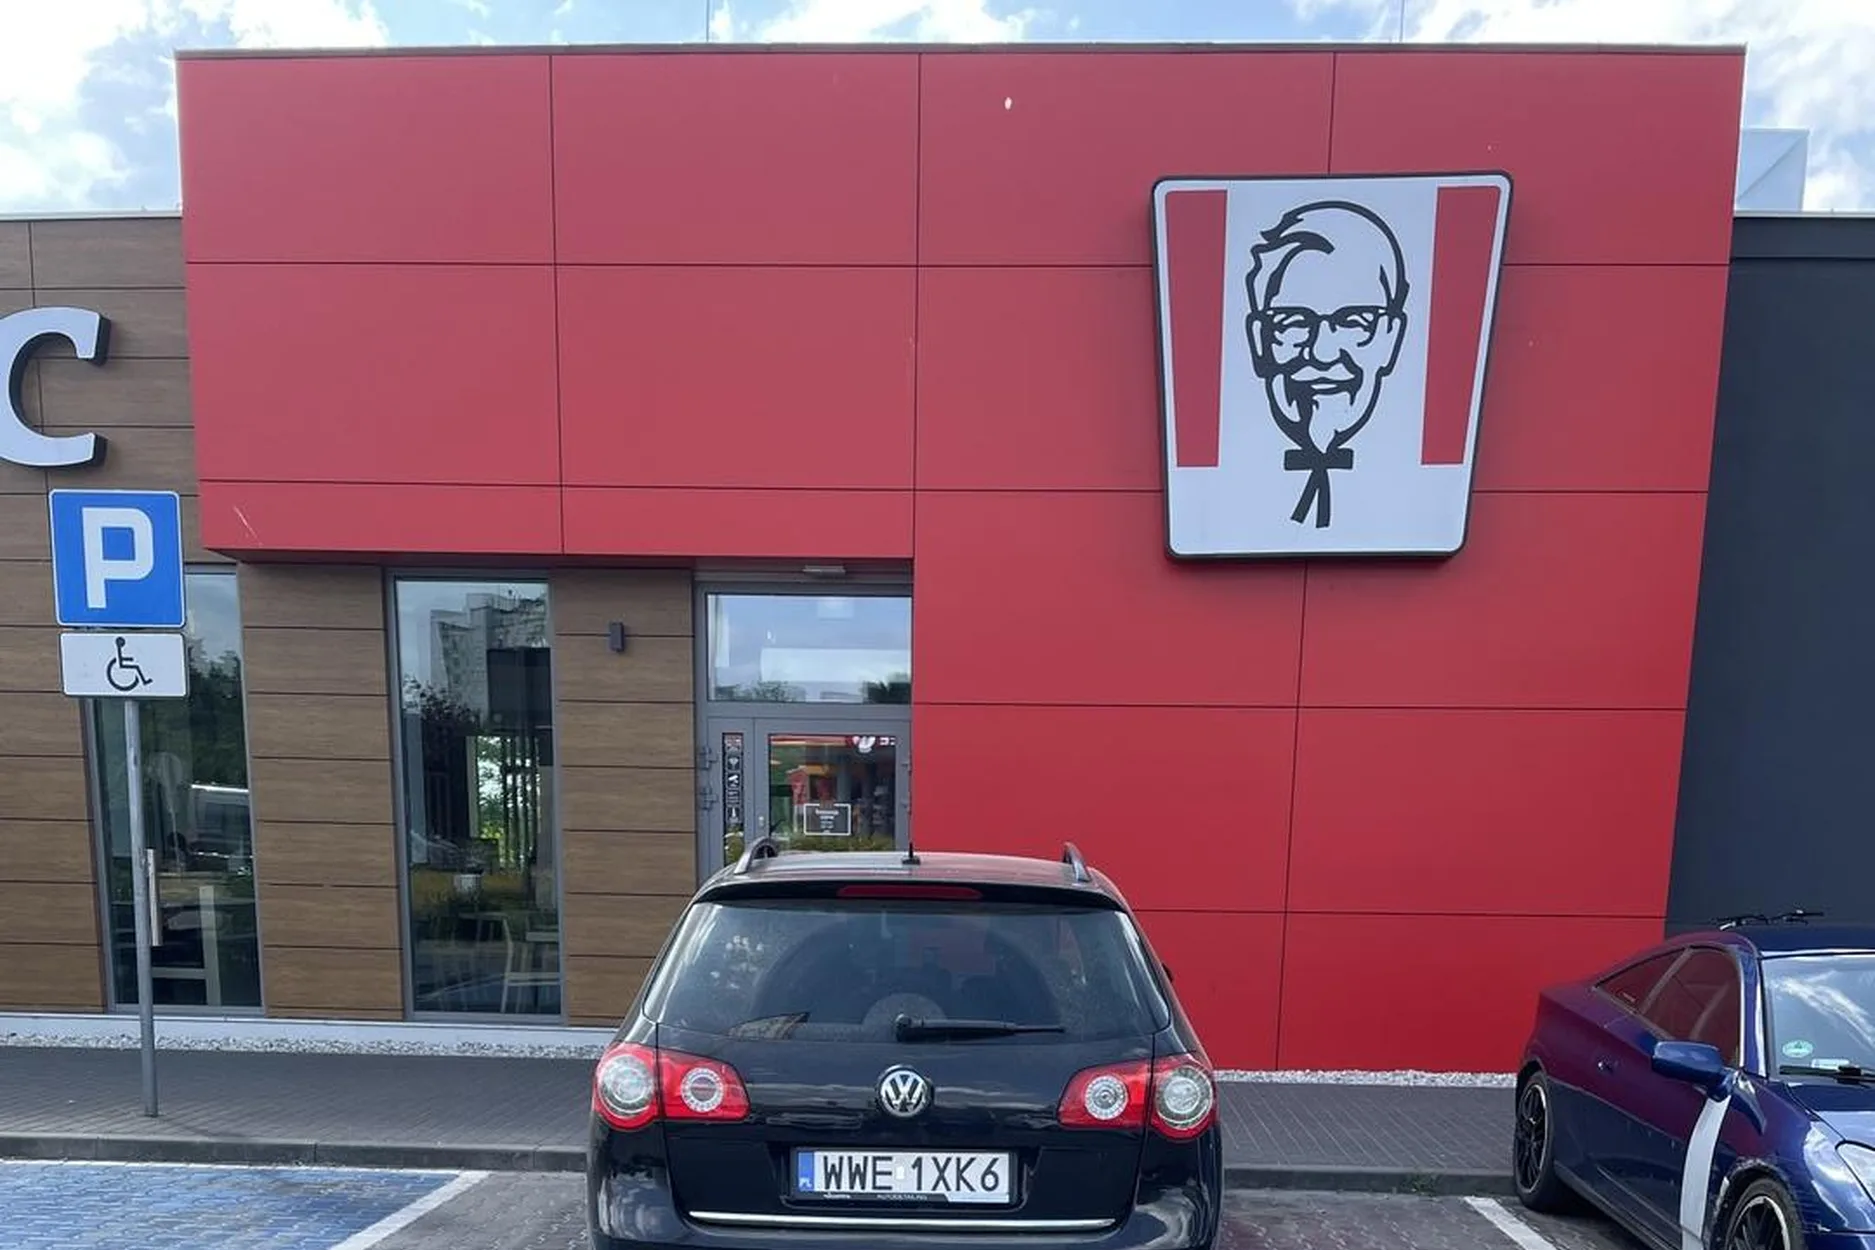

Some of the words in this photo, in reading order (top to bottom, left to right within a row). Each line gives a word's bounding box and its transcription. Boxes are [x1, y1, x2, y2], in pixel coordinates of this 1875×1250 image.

[82, 507, 154, 608] P
[799, 1177, 812, 1188] PL
[823, 1155, 893, 1191] WWE
[911, 1156, 1000, 1192] 1XK6
